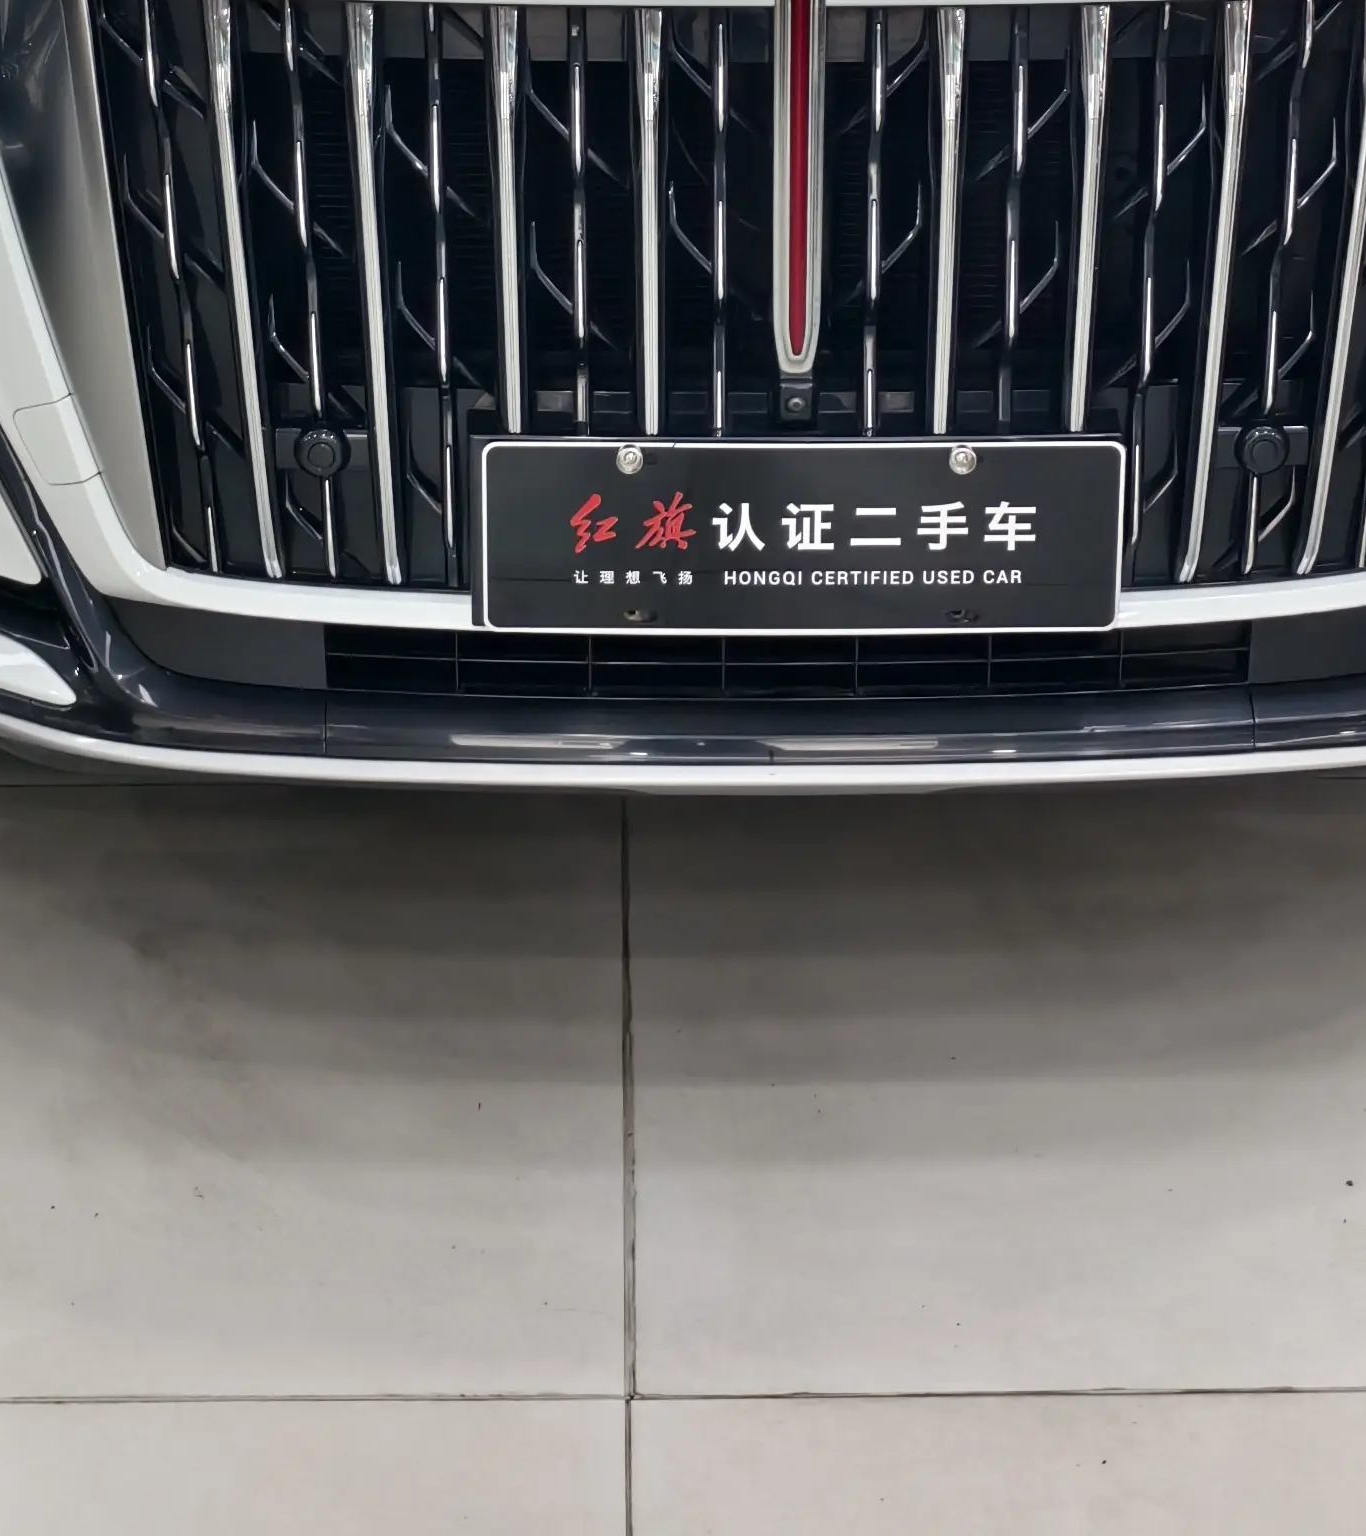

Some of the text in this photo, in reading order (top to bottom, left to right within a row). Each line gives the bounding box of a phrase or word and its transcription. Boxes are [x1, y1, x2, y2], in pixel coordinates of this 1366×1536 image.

[569, 491, 1037, 554] 红旗认证二手车
[573, 569, 693, 586] 让理想飞扬
[723, 568, 1023, 587] HONGQI CERTIFIED USED CAR
